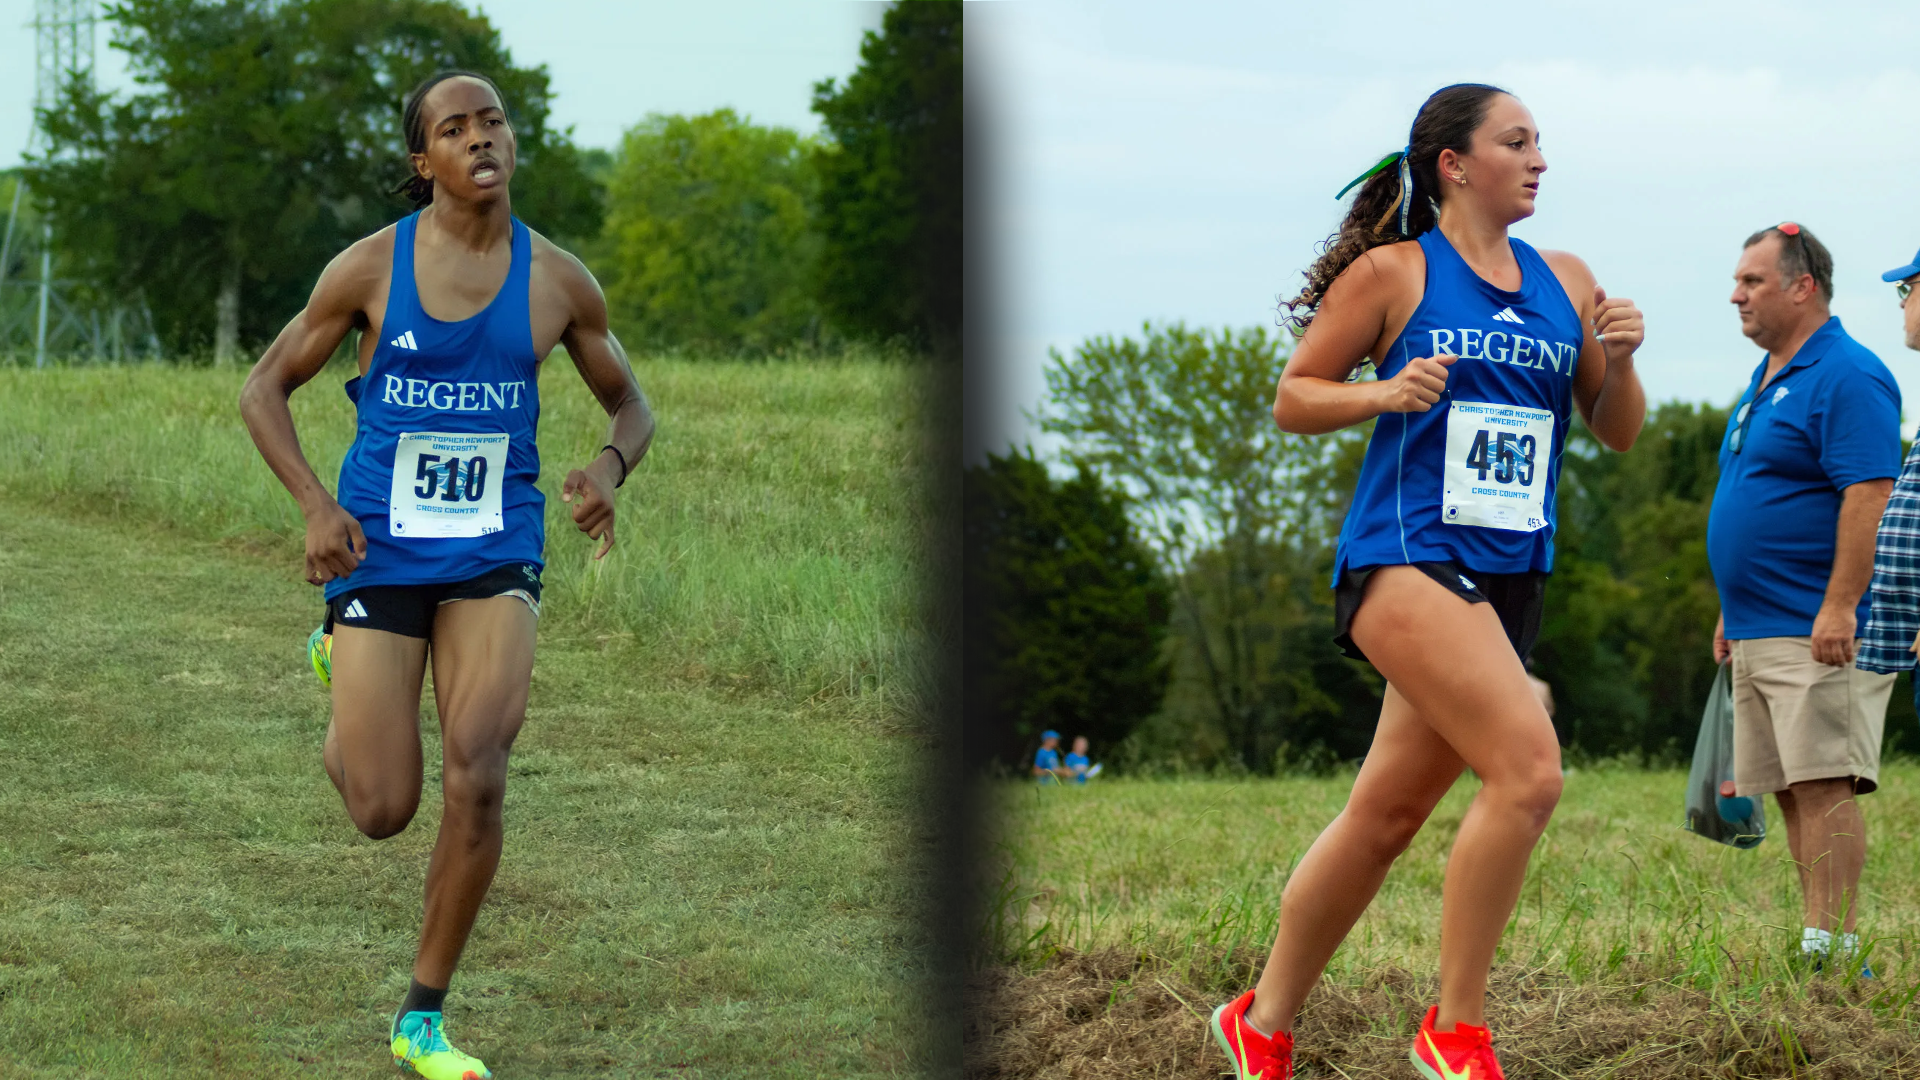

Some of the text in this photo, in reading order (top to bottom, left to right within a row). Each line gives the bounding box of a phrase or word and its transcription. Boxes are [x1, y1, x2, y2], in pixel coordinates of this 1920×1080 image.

[1428, 328, 1577, 377] REGENT
[382, 374, 526, 411] REGENT
[1515, 410, 1548, 422] NEWPORT
[1485, 417, 1528, 428] UNIVERSITY
[409, 434, 464, 444] CHRISTOPHER
[432, 443, 478, 452] UNIVERSITY
[1466, 429, 1536, 487] 453
[414, 453, 488, 502] 510
[1471, 487, 1530, 500] CROSS COUNTRY
[416, 504, 479, 514] CROSS COUNTRY
[1527, 517, 1542, 528] 453
[481, 526, 499, 535] 510
